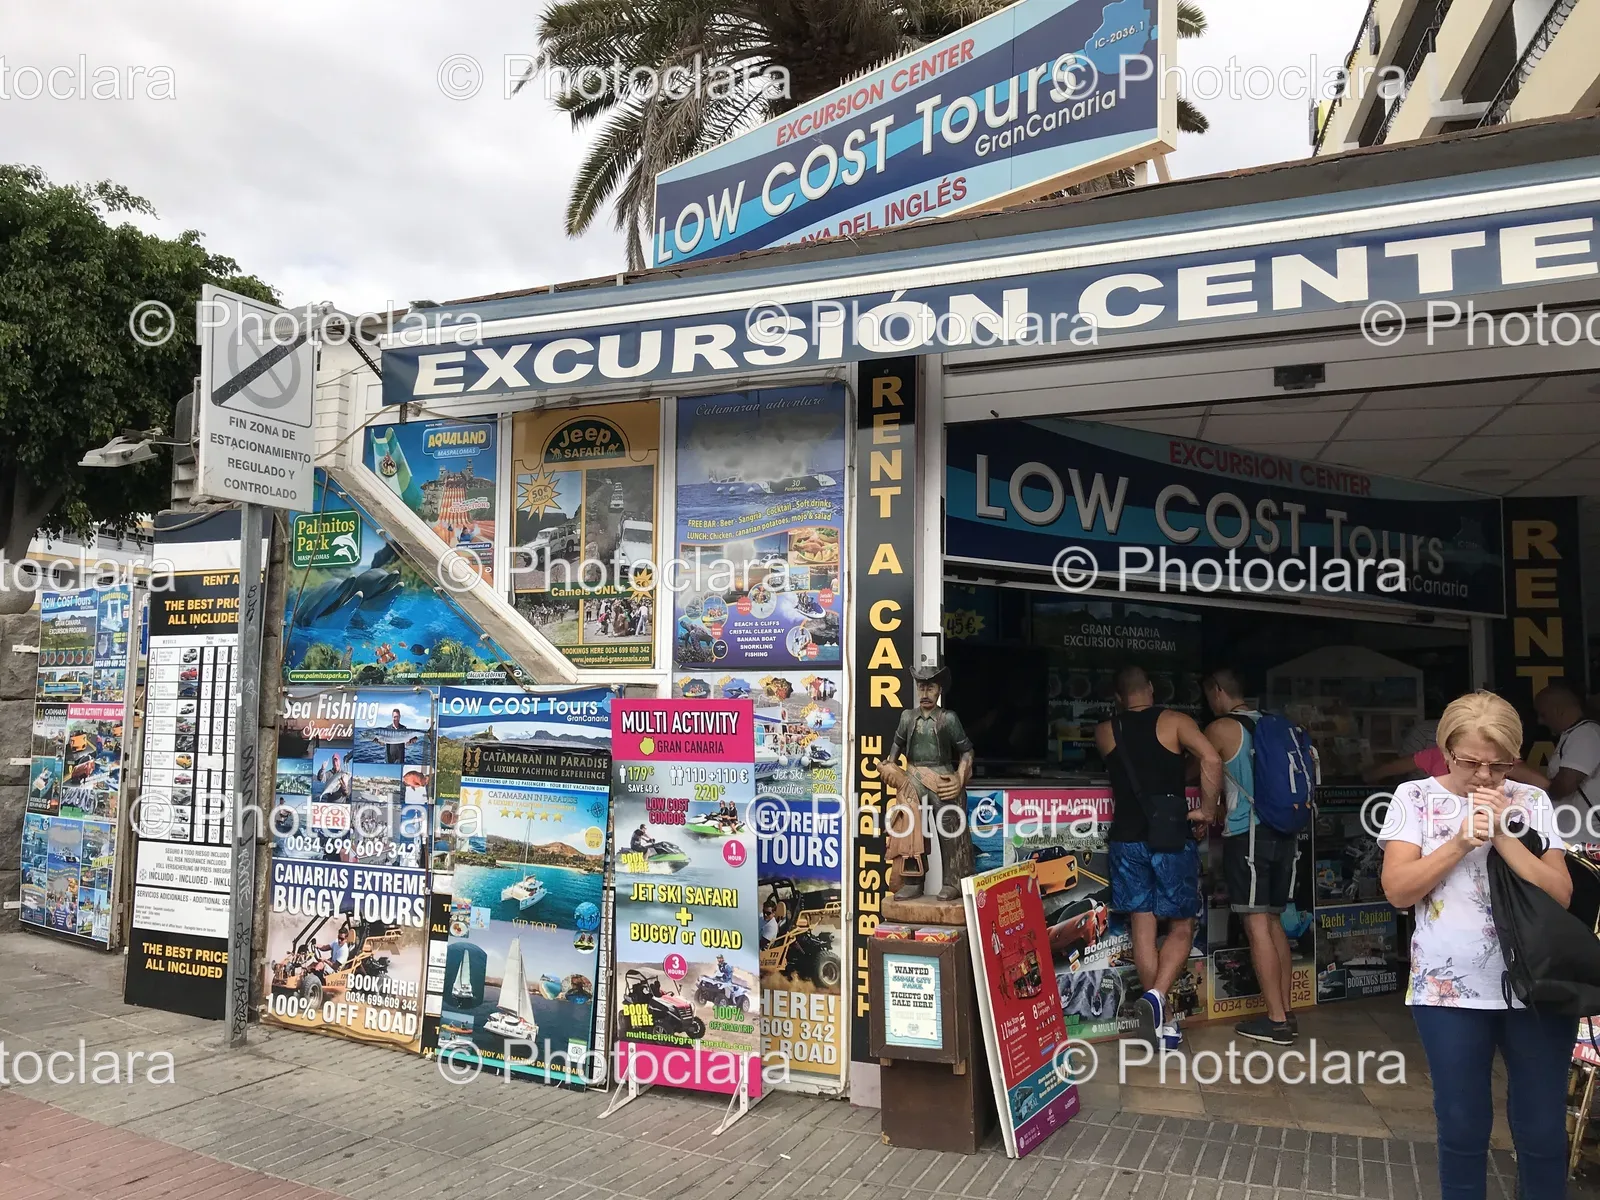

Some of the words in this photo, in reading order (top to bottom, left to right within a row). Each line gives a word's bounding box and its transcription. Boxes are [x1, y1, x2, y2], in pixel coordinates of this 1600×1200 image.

[1095, 21, 1145, 49] IC-2036.1
[776, 79, 885, 147] EXCURSION
[891, 38, 975, 93] CENTER
[975, 89, 1116, 157] GranCanaria
[658, 180, 746, 263] LOW
[762, 114, 895, 217] COST
[916, 54, 1077, 156] Tours
[838, 212, 879, 237] DEL
[885, 176, 967, 226] INGLÉS
[413, 287, 1028, 396] EXCURSIÓN
[229, 416, 247, 431] FIN
[250, 421, 279, 437] ZONA
[282, 429, 296, 441] DE
[428, 430, 487, 448] AQUALAND
[559, 427, 611, 448] Jeep
[210, 433, 311, 464] ESTACIONAMIENTO
[437, 447, 476, 457] MASPALOMAS
[564, 446, 605, 459] SAFARI
[870, 376, 904, 518] RENT
[228, 457, 286, 479] REGULADO
[288, 469, 296, 480] Y
[1169, 440, 1293, 483] EXCURSION
[1299, 464, 1372, 497] CENTER
[224, 477, 297, 501] CONTROLADO
[976, 453, 1129, 535] LOW
[1155, 483, 1306, 556] COST
[1326, 507, 1445, 576] Tours
[297, 517, 356, 536] Palmitos
[867, 543, 903, 575] A
[203, 574, 230, 586] RENT
[232, 574, 240, 585] A
[551, 586, 591, 597] Camels
[594, 584, 624, 596] ONLY
[42, 597, 56, 609] LOW
[56, 595, 73, 607] COST
[75, 595, 91, 606] Tours
[165, 600, 184, 611] THE
[187, 598, 214, 610] BEST
[216, 597, 240, 608] PRIC
[1512, 519, 1564, 700] RENT
[1081, 623, 1112, 636] GRAN
[1114, 626, 1160, 638] CANARIA
[867, 599, 903, 708] CAR
[1063, 635, 1124, 649] EXCURSION
[1126, 638, 1176, 652] PROGRAM
[291, 671, 350, 681] www.palmitospark.es
[283, 693, 312, 719] Sea
[316, 693, 379, 727] Fishing
[442, 697, 482, 715] LOW
[489, 697, 541, 715] COST
[548, 697, 598, 715] Tours
[566, 715, 609, 723] GranCanaria
[621, 711, 667, 733] MULTI
[671, 711, 739, 735] ACTIVITY
[303, 720, 353, 741] Sportfish
[657, 740, 682, 753] GRAN
[684, 740, 724, 754] CANARIA
[482, 751, 542, 765] CATAMARAN
[546, 755, 557, 766] IN
[561, 757, 608, 769] PARADISE
[485, 764, 491, 772] A
[493, 765, 519, 774] LUXURY
[521, 767, 558, 777] YACHTING
[561, 770, 606, 780] EXPERIENCE
[859, 735, 882, 836] PRICE
[646, 798, 666, 812] LOW
[667, 798, 689, 812] COST
[1024, 798, 1062, 816] MULTI
[1065, 798, 1116, 816] ACTIVITY
[313, 815, 347, 827] HERE
[648, 810, 687, 825] COMBOS
[760, 810, 839, 835] EXTREME
[287, 836, 321, 851] 0034
[325, 838, 350, 854] 699
[356, 840, 383, 856] 609
[389, 842, 416, 859] 342
[621, 852, 644, 864] BOOK
[758, 836, 839, 868] TOURS
[274, 863, 349, 889] CANARIAS
[353, 869, 426, 896] EXTREME
[993, 868, 1018, 882] TICKETS
[137, 889, 159, 899] SERVICIOS
[160, 892, 189, 902] ADICIONALES
[193, 896, 221, 906] ADDITIONAL
[630, 883, 655, 902] JET
[657, 884, 682, 904] SKI
[685, 886, 738, 908] SAFARI
[858, 847, 881, 936] BEST
[273, 885, 345, 919] BUGGY
[350, 892, 425, 928] TOURS
[675, 907, 693, 926] +
[512, 917, 529, 930] VIP
[529, 921, 558, 933] TOUR
[1320, 913, 1346, 930] Yacht
[1349, 914, 1356, 925] +
[1359, 908, 1392, 926] Captain
[630, 922, 678, 944] BUGGY
[681, 931, 695, 945] or
[700, 928, 742, 950] QUAD
[1083, 933, 1129, 955] BOOKINGS
[142, 942, 163, 956] THE
[165, 945, 193, 960] BEST
[195, 949, 228, 964] PRICE
[672, 956, 680, 968] 3
[145, 957, 165, 971] ALL
[167, 960, 223, 979] INCLUDED
[667, 968, 685, 976] HOURS
[894, 965, 929, 976] WANTED
[347, 973, 379, 993] BOOK
[382, 977, 418, 997] HERE!
[1347, 974, 1378, 989] BOOKINGS
[1379, 971, 1397, 985] HERE
[345, 991, 365, 1004] 0034
[367, 994, 382, 1007] 699
[384, 996, 400, 1008] 609
[401, 999, 417, 1011] 342
[890, 991, 921, 1000] TICKETS
[923, 992, 934, 1001] ON
[892, 999, 911, 1008] SALE
[913, 1000, 933, 1009] HERE
[266, 992, 316, 1021] 100%
[322, 1001, 359, 1026] OFF
[365, 1007, 417, 1036] ROAD
[623, 1003, 649, 1016] BOOK
[630, 1014, 654, 1026] HERE
[712, 1005, 745, 1022] 100%
[760, 1018, 794, 1038] 609
[800, 1023, 835, 1043] 342
[780, 1040, 837, 1065] ROAD
